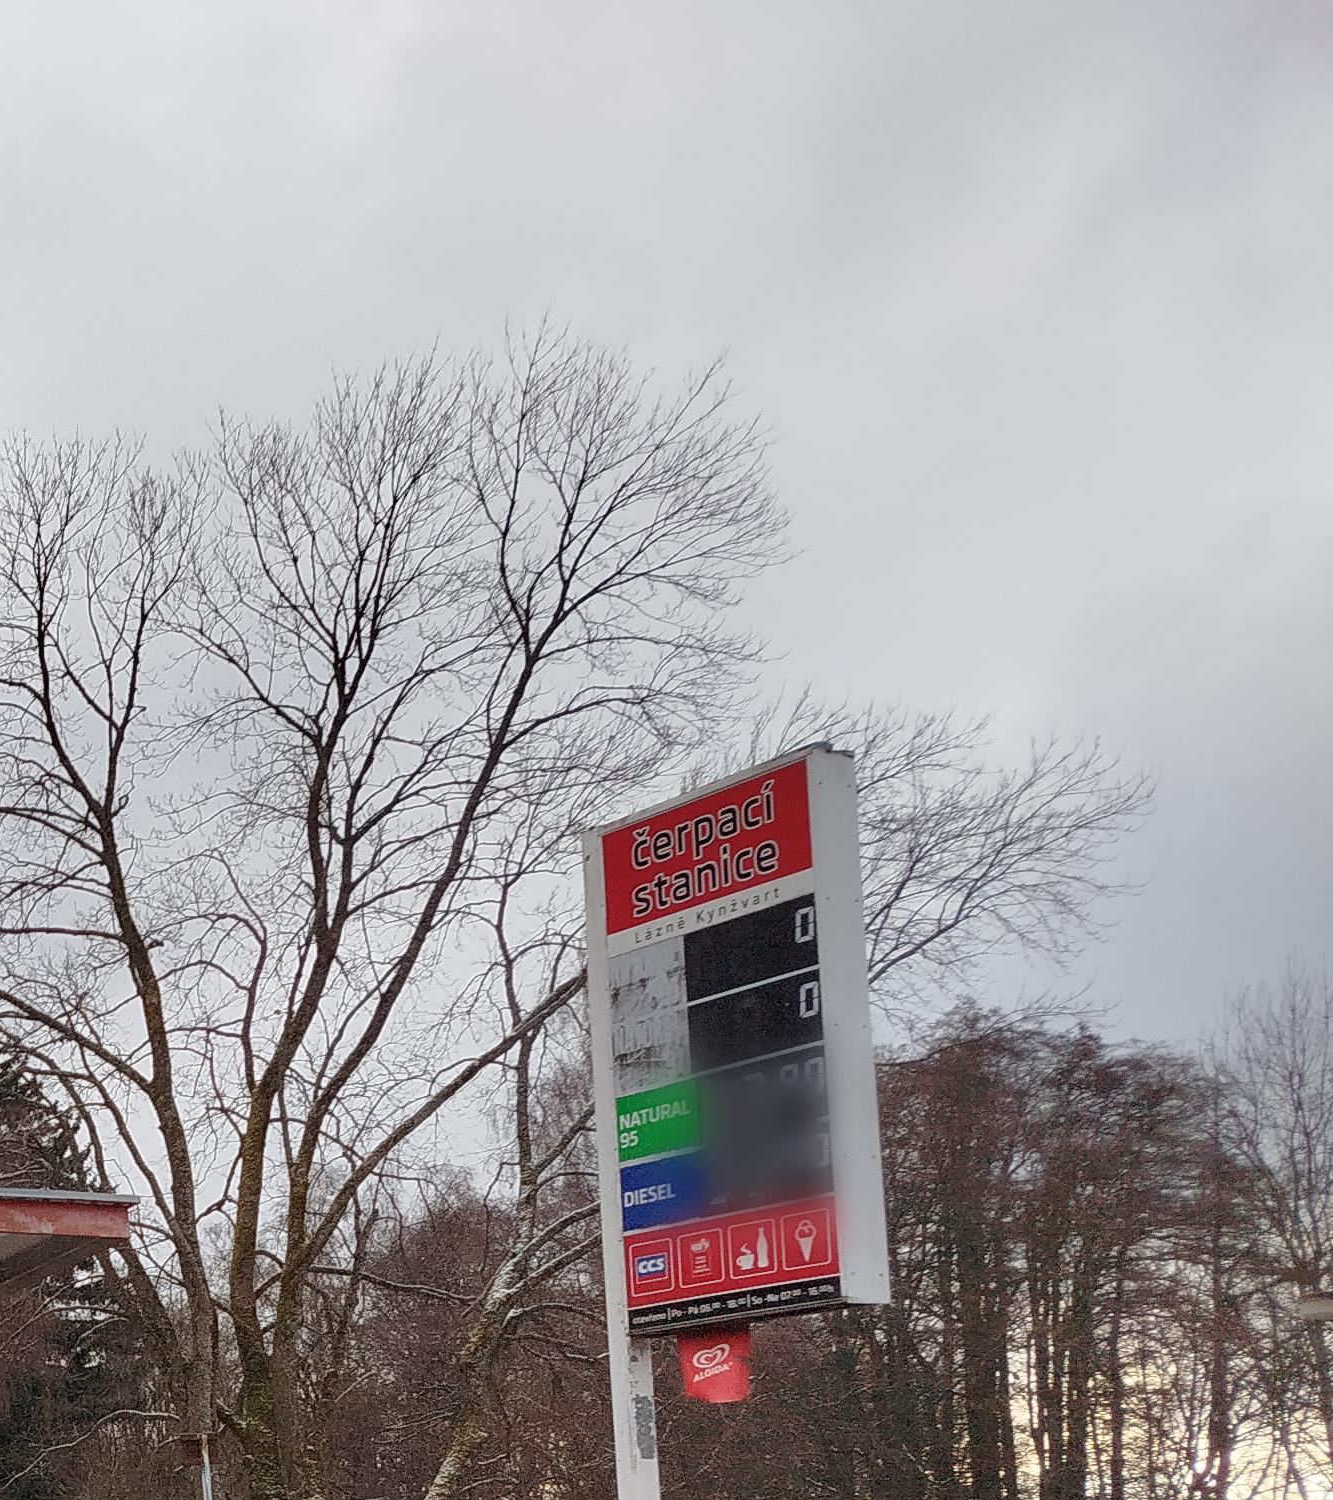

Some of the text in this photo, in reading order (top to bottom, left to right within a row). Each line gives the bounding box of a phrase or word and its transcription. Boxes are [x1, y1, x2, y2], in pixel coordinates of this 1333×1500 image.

[631, 779, 775, 870] čerpací
[632, 840, 779, 918] stanice
[635, 887, 781, 945] Lázně Kynžvart
[619, 1099, 691, 1130] NATURAL
[619, 1130, 639, 1149] 95
[624, 1182, 677, 1208] DIESEL
[638, 1257, 665, 1274] CCS
